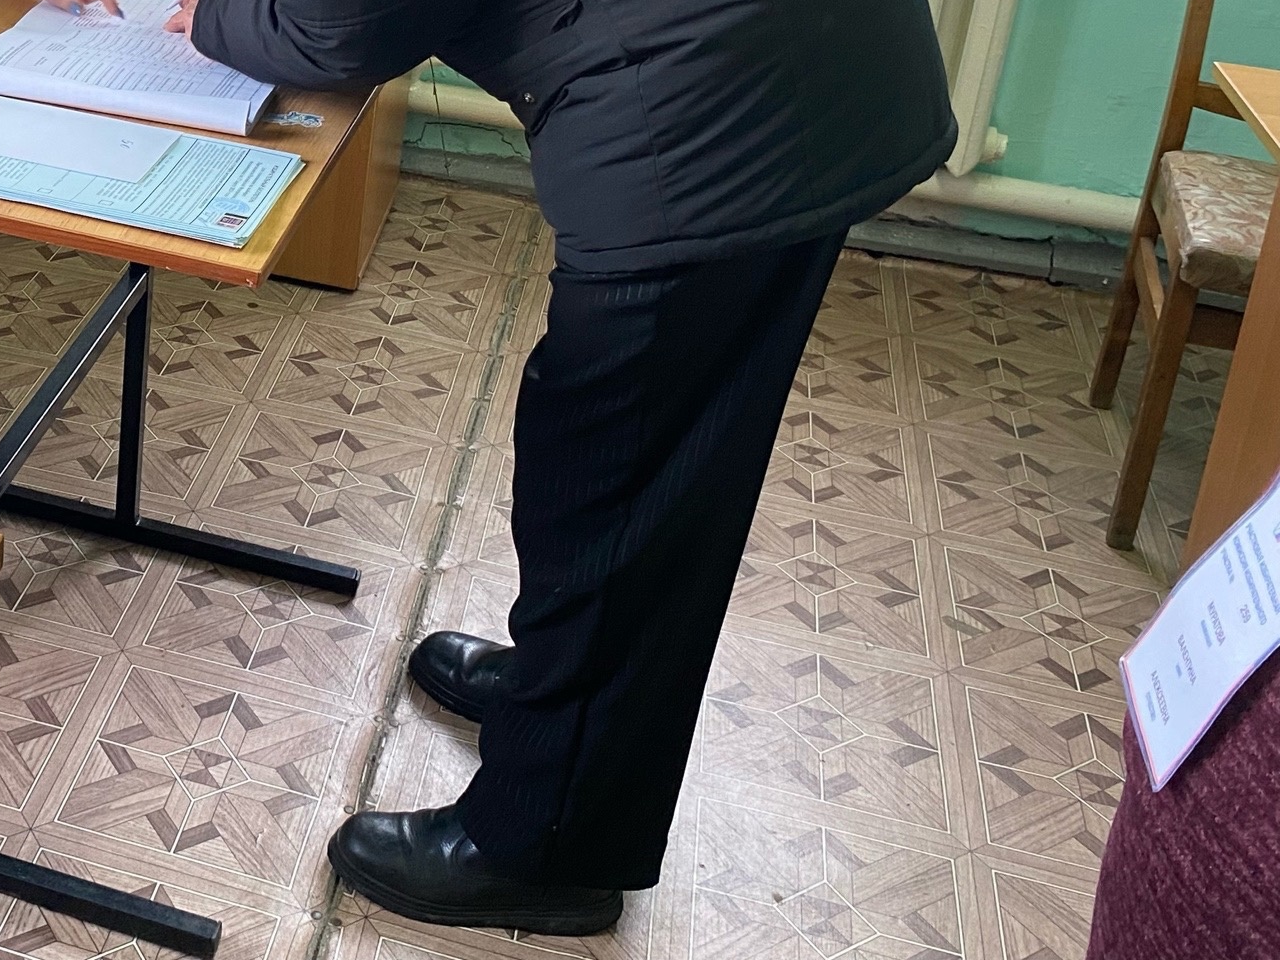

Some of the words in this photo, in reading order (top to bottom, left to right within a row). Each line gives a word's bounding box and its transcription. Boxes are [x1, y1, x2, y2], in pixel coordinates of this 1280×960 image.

[1207, 600, 1226, 646] МУРАТОВА
[1239, 604, 1251, 624] 259
[1178, 634, 1197, 686] ВАЛЕНТИНА
[1151, 670, 1170, 726] АЛЕКСЕЕВНА
